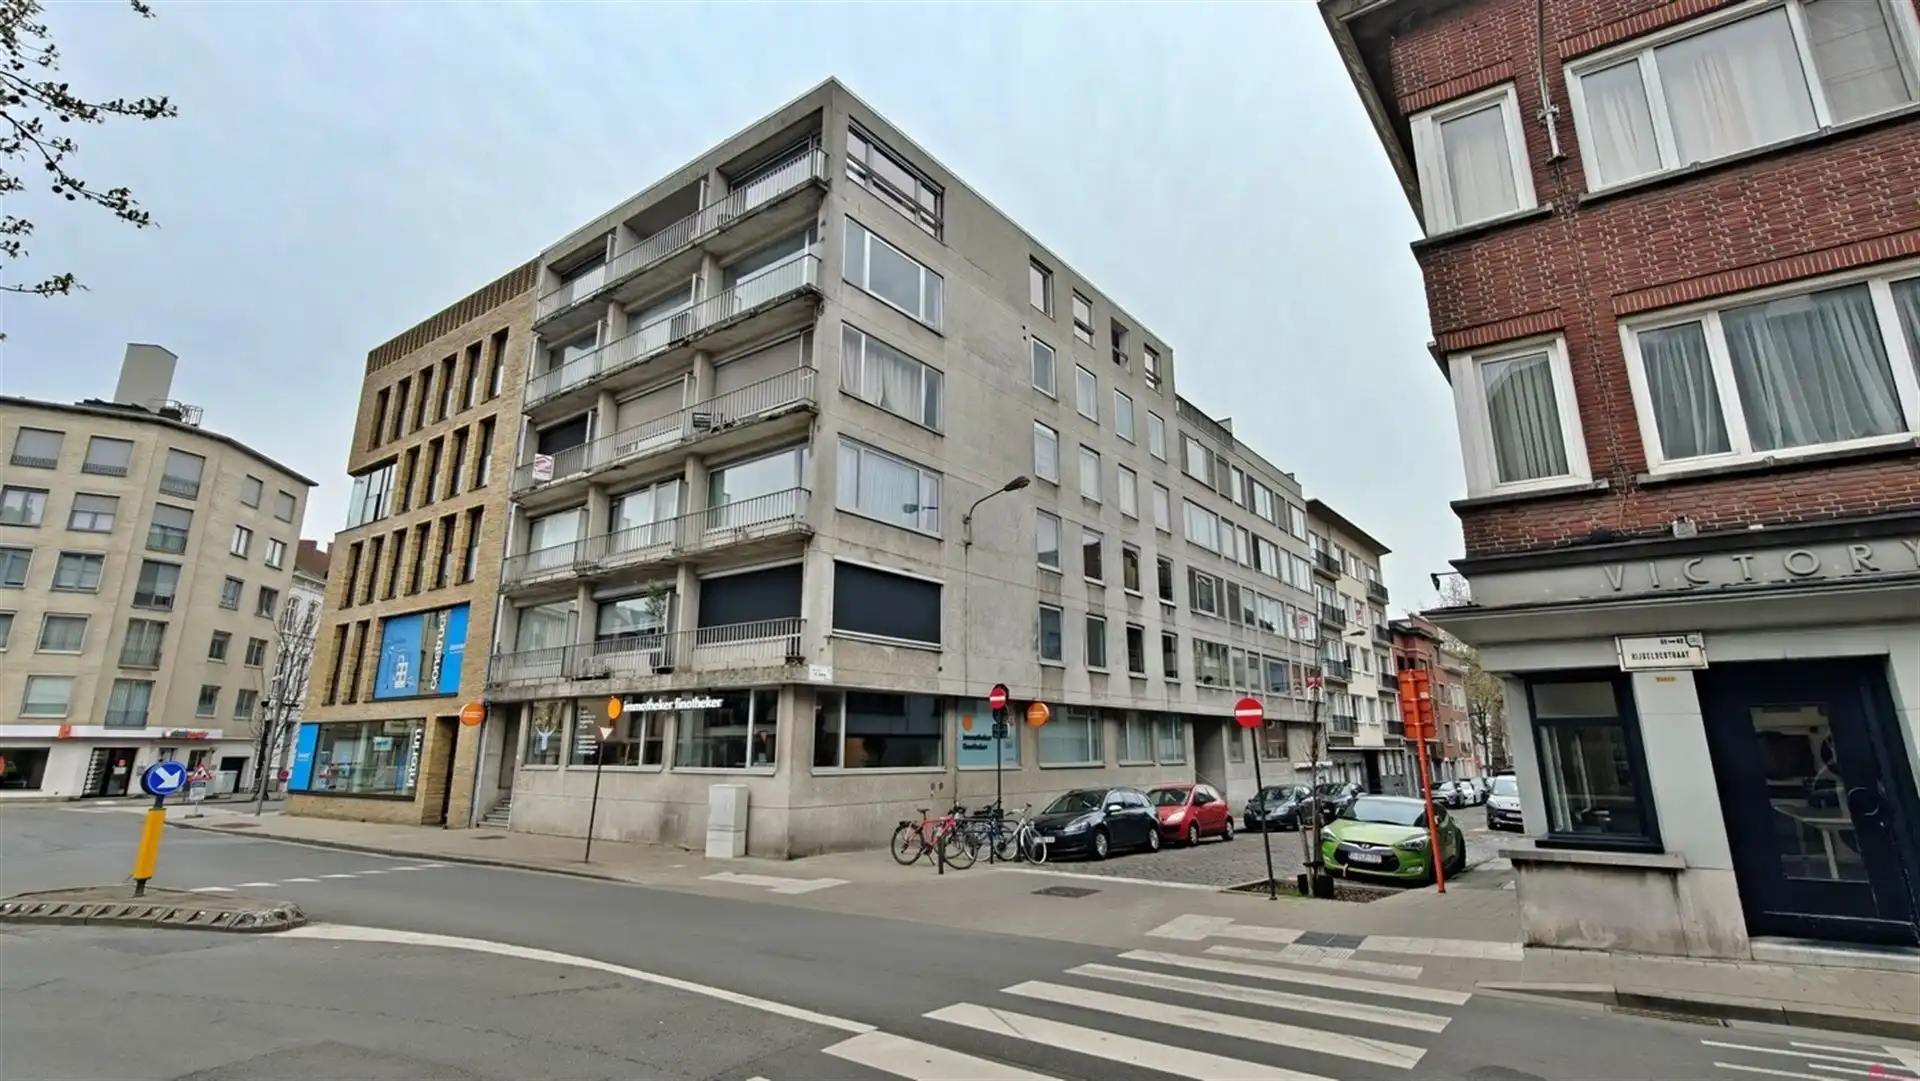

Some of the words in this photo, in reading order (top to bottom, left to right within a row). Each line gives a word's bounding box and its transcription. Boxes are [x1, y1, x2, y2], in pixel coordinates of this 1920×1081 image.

[1603, 538, 1920, 592] VICTORY
[623, 697, 674, 712] immotheker
[675, 695, 724, 709] finotheker
